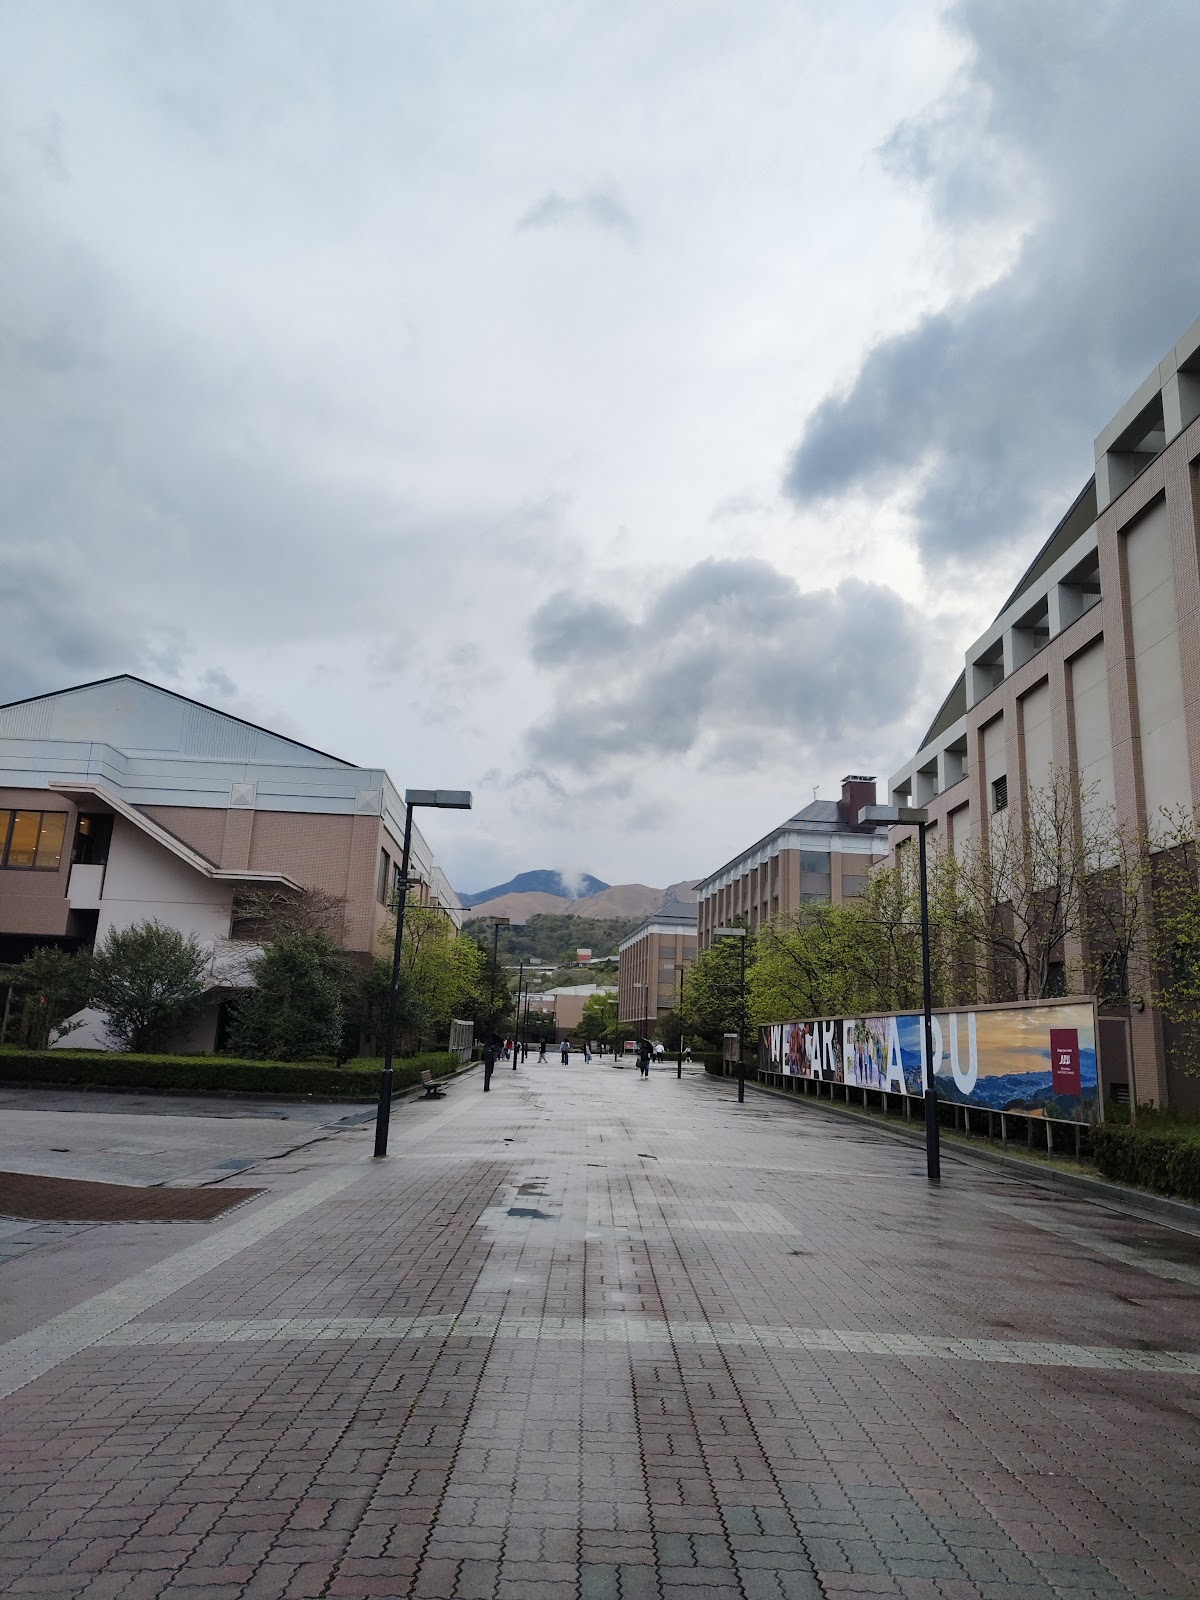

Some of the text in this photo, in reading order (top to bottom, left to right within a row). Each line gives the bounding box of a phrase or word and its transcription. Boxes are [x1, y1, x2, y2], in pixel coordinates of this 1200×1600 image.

[771, 1012, 978, 1099] WE ARE APU
